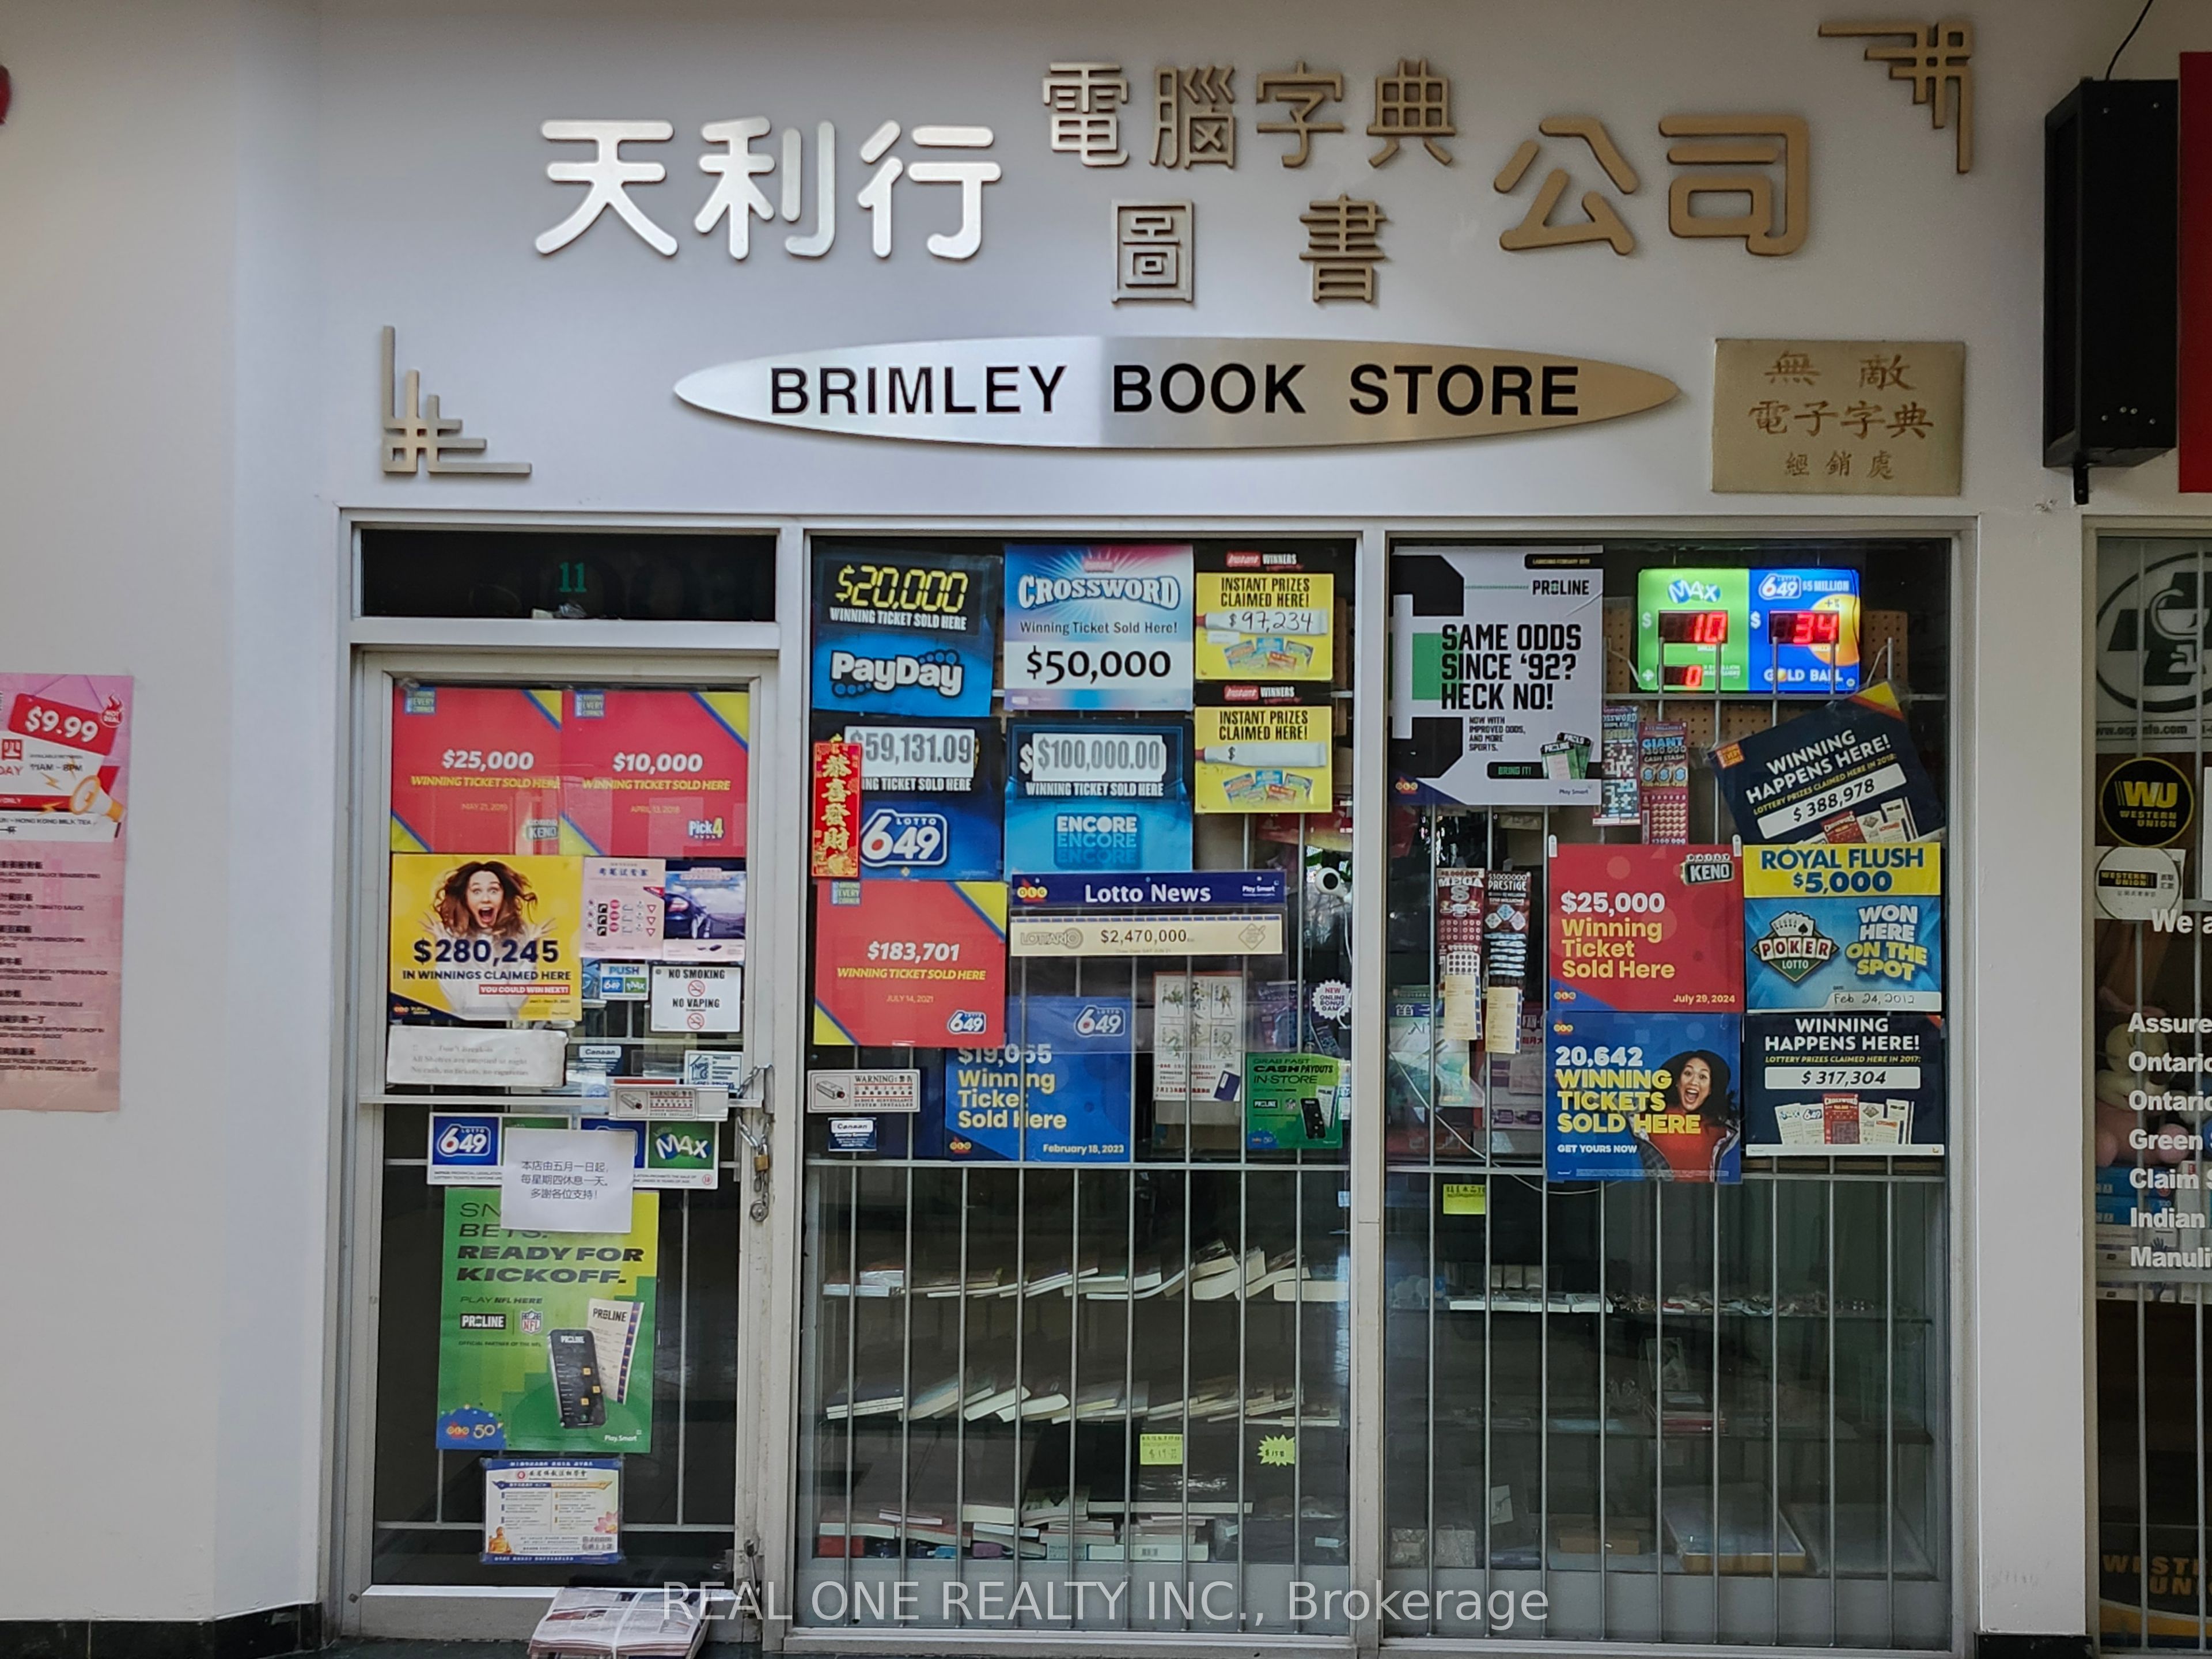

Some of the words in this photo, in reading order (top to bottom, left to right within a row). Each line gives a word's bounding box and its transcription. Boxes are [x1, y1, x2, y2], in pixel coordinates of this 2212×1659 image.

[1042, 59, 1456, 169] 電腦字典
[535, 116, 1001, 259] 天利行
[1494, 115, 1809, 256] 公司
[1111, 194, 1388, 306] 圖書
[1764, 350, 1916, 391] 無敵
[770, 365, 1066, 416] BRIMLEY
[1113, 364, 1307, 414] BOOK
[1349, 365, 1580, 416] STORE
[1748, 400, 1934, 440] 電子字典
[1785, 450, 1894, 479] 經銷處
[1262, 554, 1297, 565] WINNERS
[559, 562, 587, 592] 11
[1221, 577, 1267, 592] INSTANT
[1272, 578, 1310, 592] PRIZES
[1814, 579, 1850, 592] MILLION
[835, 564, 969, 613] $20,000
[1018, 574, 1181, 611] CROSSWORD
[1532, 580, 1589, 595] PROLINE
[1221, 593, 1272, 608] CLAIMED
[1277, 593, 1309, 608] HERE!
[830, 607, 876, 624] WINNING
[877, 610, 912, 627] TICKET
[914, 612, 940, 628] SOLD
[941, 615, 968, 631] HERE
[1241, 611, 1313, 633] 97,234
[1793, 612, 1839, 644] 34
[1020, 622, 1070, 636] Winning
[1073, 622, 1109, 633] Ticket
[1113, 622, 1139, 633] Sold
[1145, 622, 1177, 633] Here!
[1441, 624, 1509, 651] SAME
[1517, 624, 1581, 651] ODDS
[831, 652, 963, 696] PayDay
[1027, 645, 1171, 685] $50,000
[1441, 654, 1512, 680] SINCE
[1260, 686, 1295, 698] WINNERS
[1441, 683, 1504, 710] HECK
[1513, 683, 1554, 710] NO!
[25, 705, 99, 743] $9.99
[1219, 710, 1266, 725] INSTANT
[1270, 710, 1308, 725] PRIZES
[1219, 726, 1271, 740] CLAIMED
[1275, 726, 1308, 740] HERE!
[1642, 737, 1684, 748] GIANT
[442, 749, 535, 772] $25,000
[1766, 729, 1857, 775] WINNING
[613, 752, 703, 775] $10,000
[1498, 767, 1520, 775] BRING
[411, 776, 461, 787] WINNING
[463, 777, 501, 787] TICKET
[502, 777, 531, 788] SOLD
[532, 777, 561, 789] HERE
[583, 779, 632, 790] WINNING
[634, 780, 671, 791] TICKET
[673, 781, 701, 791] SOLD
[702, 781, 731, 791] HERE
[881, 778, 916, 791] TICKET
[918, 778, 945, 791] SOLD
[946, 779, 972, 791] HERE
[1025, 782, 1071, 796] WINNING
[1074, 782, 1108, 796] TICKET
[1110, 783, 1137, 796] SOLD
[1138, 783, 1164, 797] HERE
[1745, 759, 1833, 804] HAPPENS
[822, 755, 852, 851] 恭喜發財
[1807, 778, 1875, 818] 388,978
[2119, 810, 2177, 819] WESTERN
[2137, 819, 2177, 828] UNION
[1056, 816, 1137, 833] ENCORE
[1686, 854, 1730, 862] DAILY
[1761, 848, 1842, 869] ROYAL
[1849, 848, 1923, 868] FLUSH
[1438, 877, 1483, 888] MEGA
[1488, 880, 1527, 891] PRESTIGE
[1793, 870, 1892, 894] $5,000
[1085, 884, 1143, 903] Lotto
[1152, 884, 1211, 903] News
[1561, 890, 1665, 917] $25,000
[1858, 905, 1918, 923] WON
[2151, 908, 2193, 934] We
[1100, 929, 1187, 945] $2,470,000
[1562, 917, 1662, 943] Winning
[1859, 923, 1915, 942] HERE
[414, 937, 559, 966] $280,245
[868, 941, 960, 964] $183,701
[1562, 938, 1635, 957] Ticket
[1761, 940, 1830, 957] POKER
[1846, 941, 1880, 959] ON
[1885, 941, 1927, 965] THE
[609, 966, 640, 975] PUSH
[1562, 960, 1613, 978] Sold
[1619, 960, 1675, 978] Here
[1782, 959, 1809, 969] LOTTO
[1857, 960, 1915, 981] SPOT
[418, 971, 481, 980] WINNINGS
[484, 971, 538, 980] CLAIMED
[541, 971, 571, 980] HERE
[668, 969, 681, 978] NO
[683, 969, 725, 979] SMOKING
[837, 968, 888, 978] WINNING
[889, 969, 927, 979] TICKET
[928, 969, 956, 980] SOLD
[957, 970, 986, 980] HERE
[673, 999, 685, 1007] NO
[687, 999, 720, 1008] VAPING
[1673, 994, 1694, 1005] July
[1711, 995, 1735, 1003] 2024
[1834, 993, 1854, 1004] Feb
[1796, 1017, 1889, 1033] WINNING
[1765, 1036, 1856, 1051] HAPPENS
[1862, 1035, 1920, 1050] HERE!
[1556, 1046, 1643, 1067] 20,642
[1301, 1065, 1334, 1073] PAYOUTS
[1816, 1070, 1887, 1087] 317,304
[1556, 1069, 1672, 1089] WINNING
[1557, 1091, 1666, 1112] TICKETS
[958, 1111, 1007, 1128] Sold
[1557, 1113, 1626, 1133] SOLD
[1634, 1114, 1700, 1134] HERE
[656, 1134, 709, 1158] MAX
[1043, 1143, 1087, 1156] February
[1557, 1145, 1577, 1153] GET
[1580, 1145, 1612, 1153] YOURS
[1613, 1145, 1637, 1153] NOW
[2128, 1129, 2203, 1151] Green
[2129, 1168, 2199, 1190] Claim
[2130, 1207, 2206, 1229] Indian
[457, 1245, 572, 1260] READY
[576, 1247, 645, 1262] FOR
[457, 1267, 626, 1284] KICKOFF.
